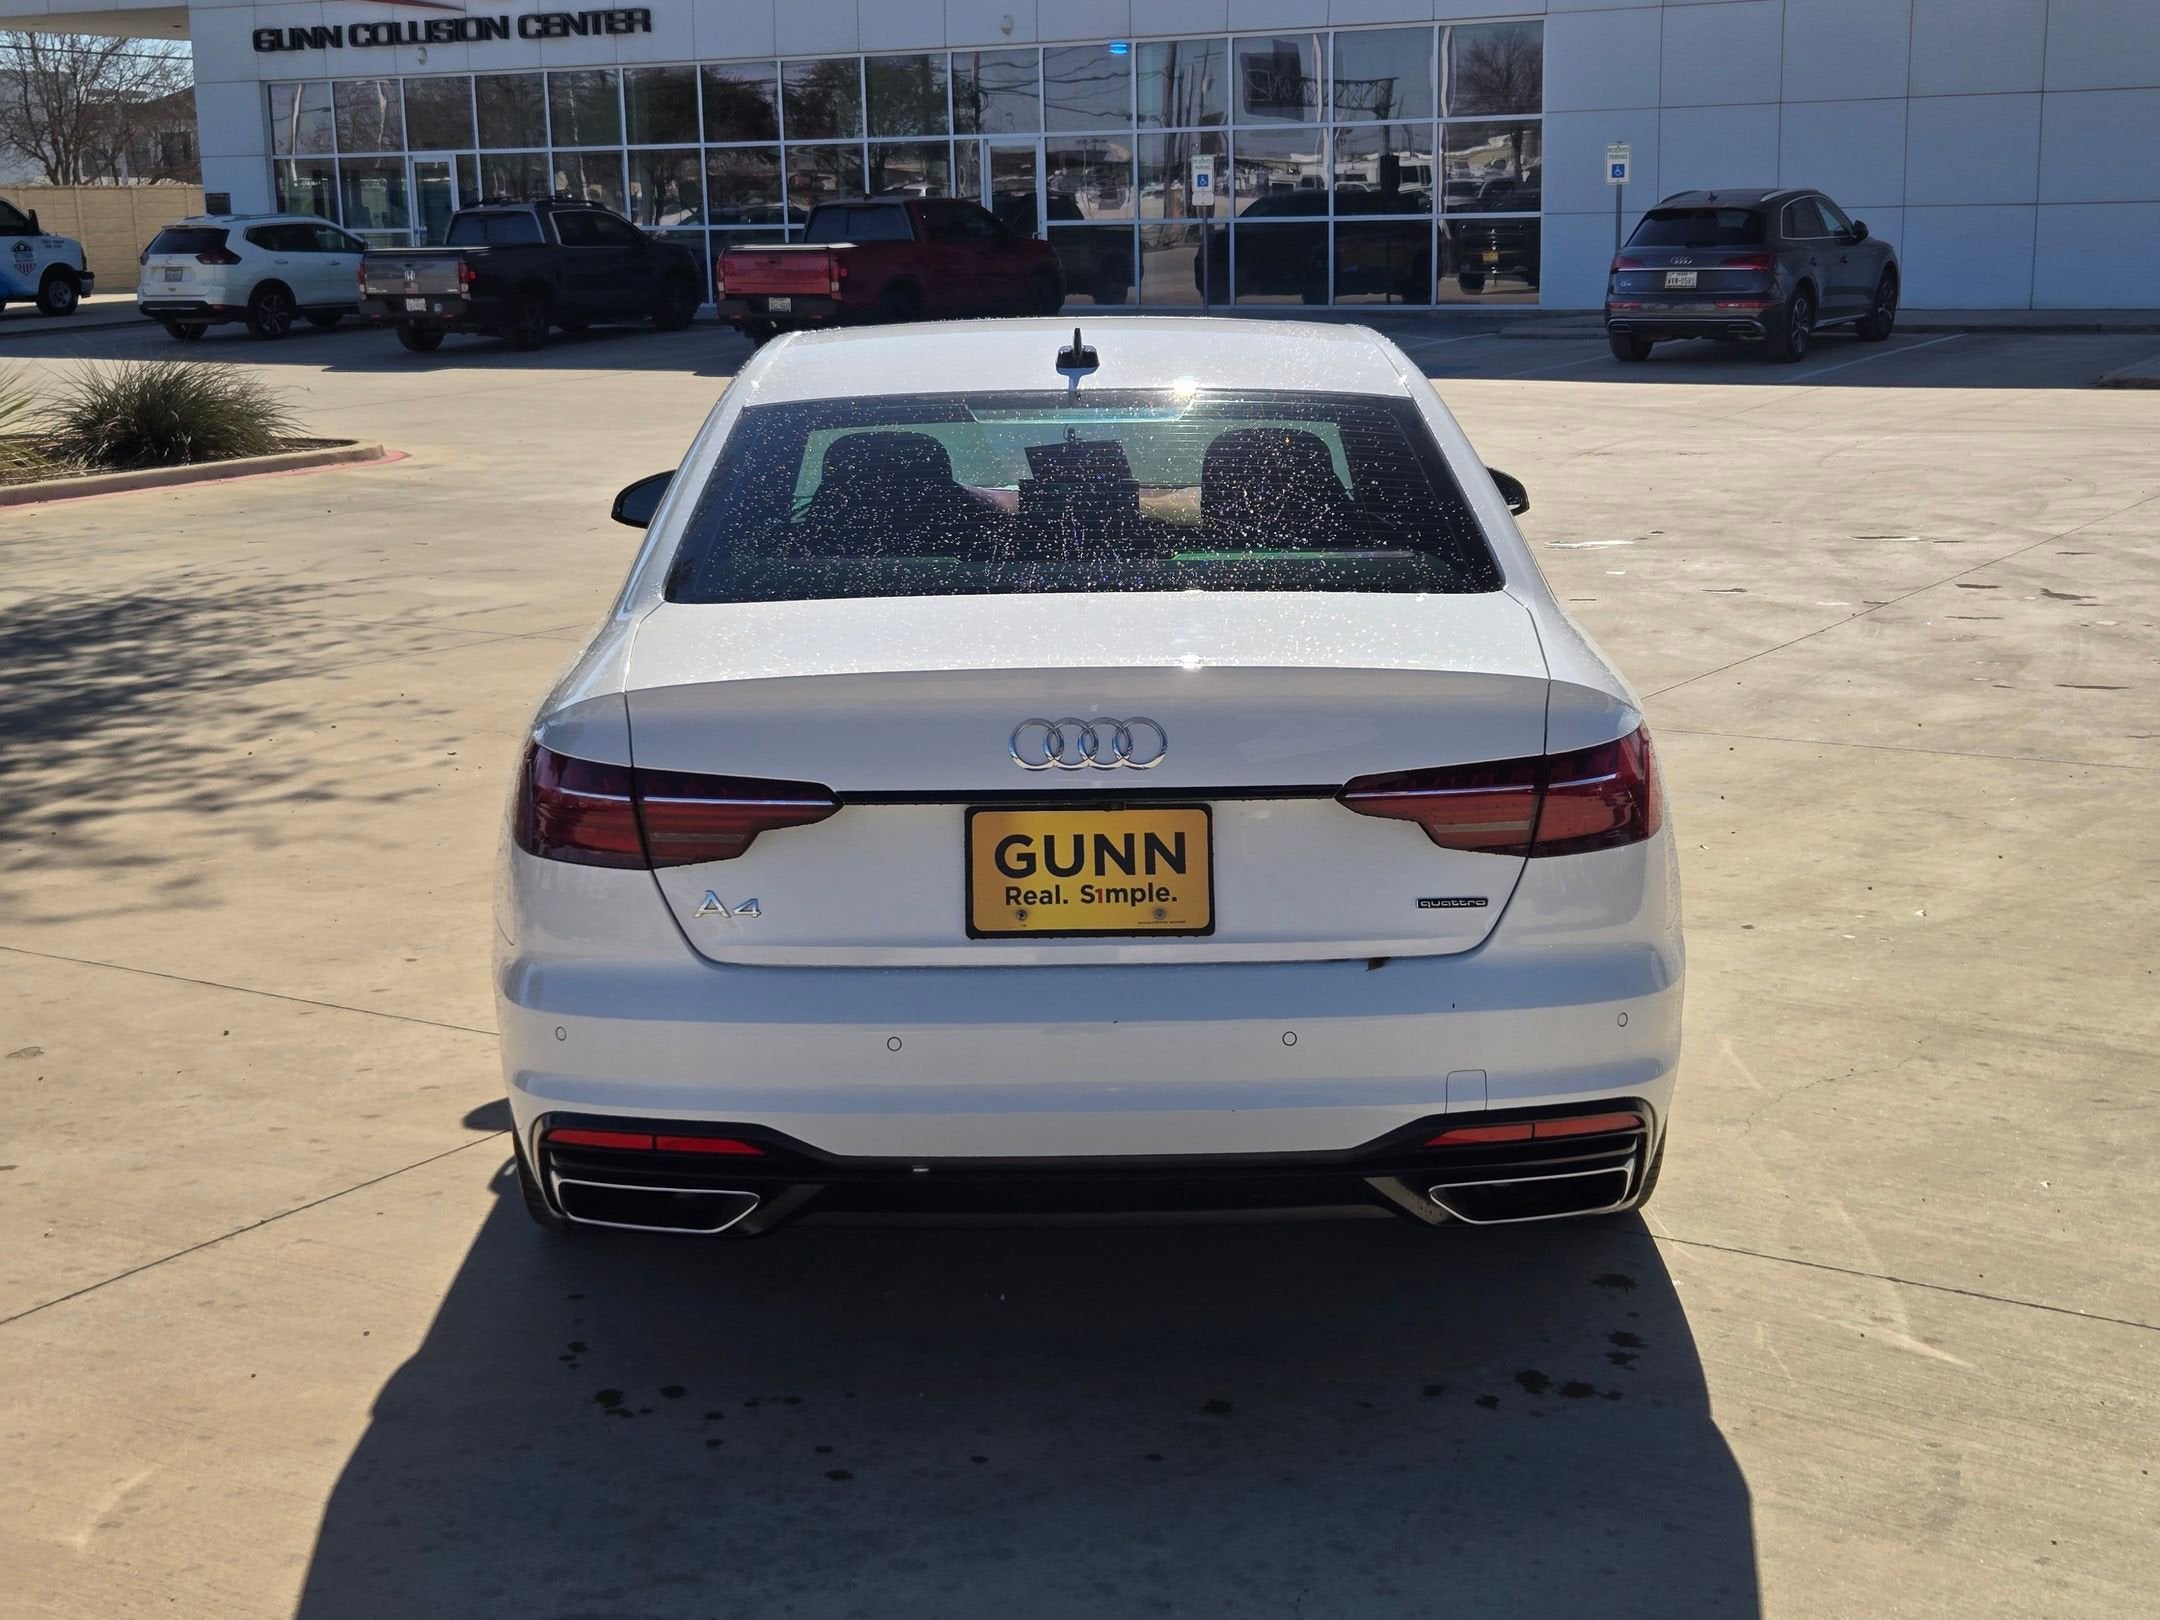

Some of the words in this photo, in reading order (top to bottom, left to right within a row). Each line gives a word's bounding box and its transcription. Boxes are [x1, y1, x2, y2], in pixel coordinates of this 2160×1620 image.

[252, 25, 344, 52] GUNN
[348, 15, 510, 47] COLLISION
[518, 8, 652, 39] CENTER
[995, 832, 1187, 879] GUNN
[694, 890, 762, 918] A4
[1005, 884, 1069, 906] Real.
[1419, 899, 1487, 908] quattro
